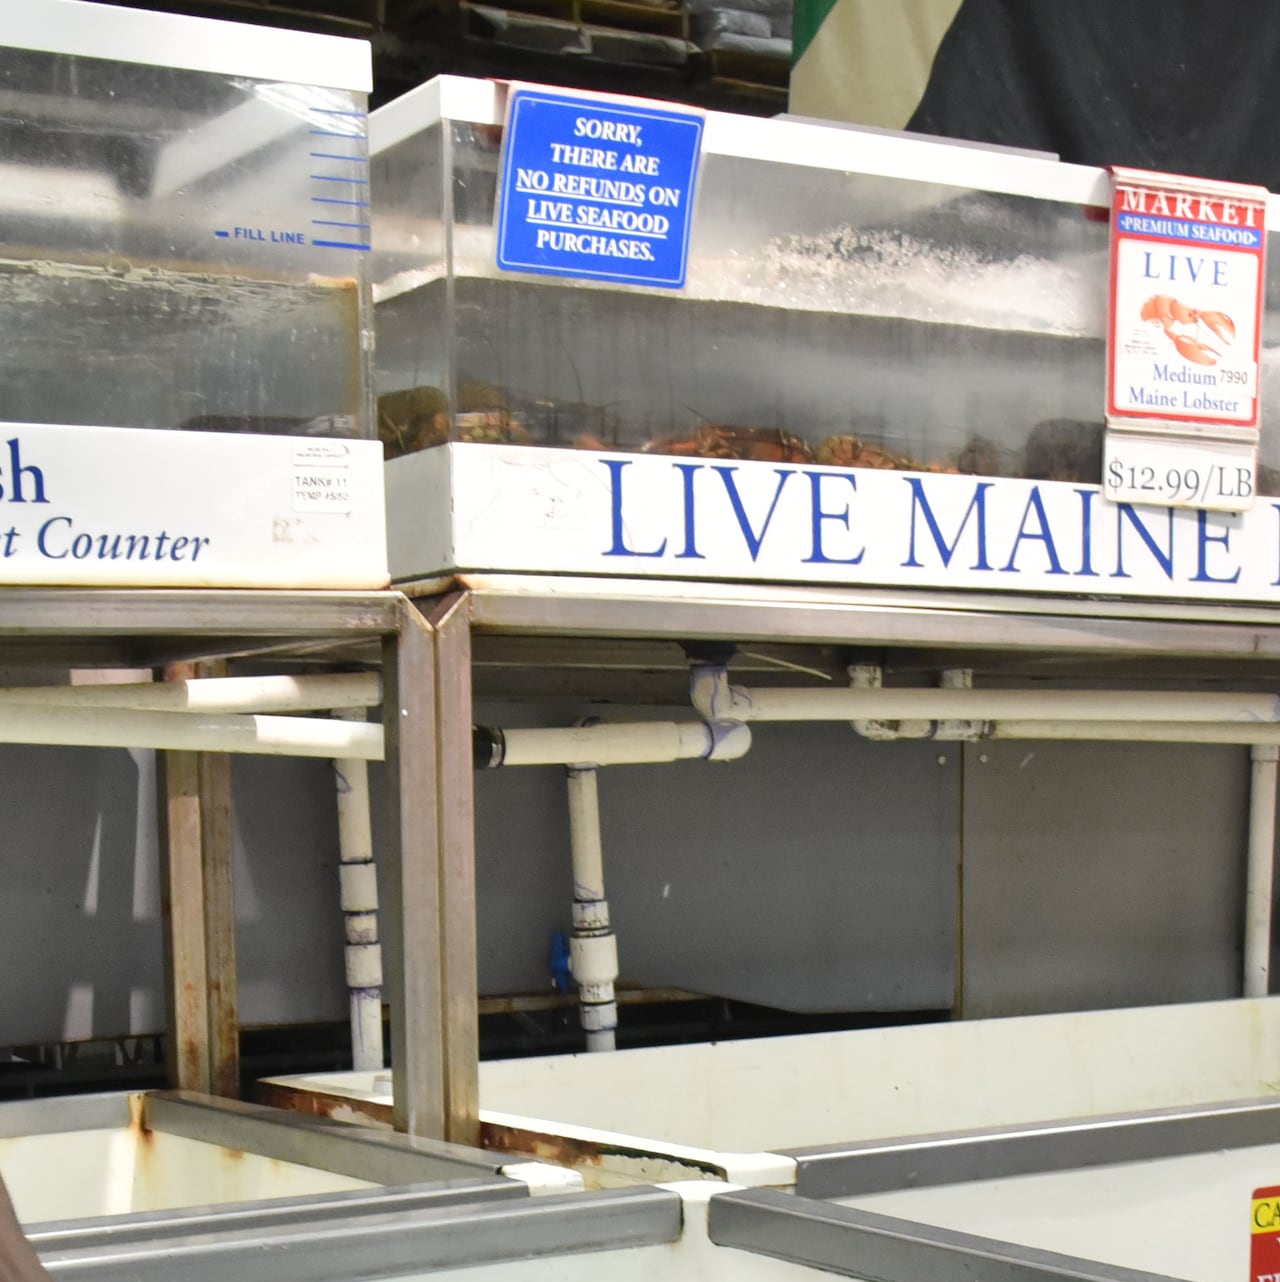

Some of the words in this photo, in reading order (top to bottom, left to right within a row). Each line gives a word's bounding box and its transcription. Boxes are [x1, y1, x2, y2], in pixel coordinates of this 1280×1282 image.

[574, 117, 643, 147] SORRY,
[550, 143, 618, 171] THERE
[620, 153, 660, 176] ARE
[516, 168, 549, 189] NO
[553, 174, 646, 201] REFUNDS
[649, 186, 680, 208] ON
[527, 199, 573, 223] LIVE
[576, 205, 669, 234] SEAFOOD
[1121, 189, 1263, 227] MARKET
[234, 227, 266, 241] FILL
[271, 231, 304, 245] LINE
[536, 229, 655, 262] PURCHASES.
[1124, 216, 1189, 237] PREMIUM
[1192, 225, 1253, 246] SEAFOOD
[1143, 252, 1228, 287] LIVE
[1153, 364, 1217, 386] Medium
[1220, 369, 1248, 385] 7990
[1128, 386, 1179, 408] Maine
[1183, 391, 1239, 413] Lobster
[1108, 457, 1252, 503] $12.99/LB
[598, 459, 866, 565] LIVE
[899, 477, 1242, 583] MAINE
[37, 517, 210, 563] Counter
